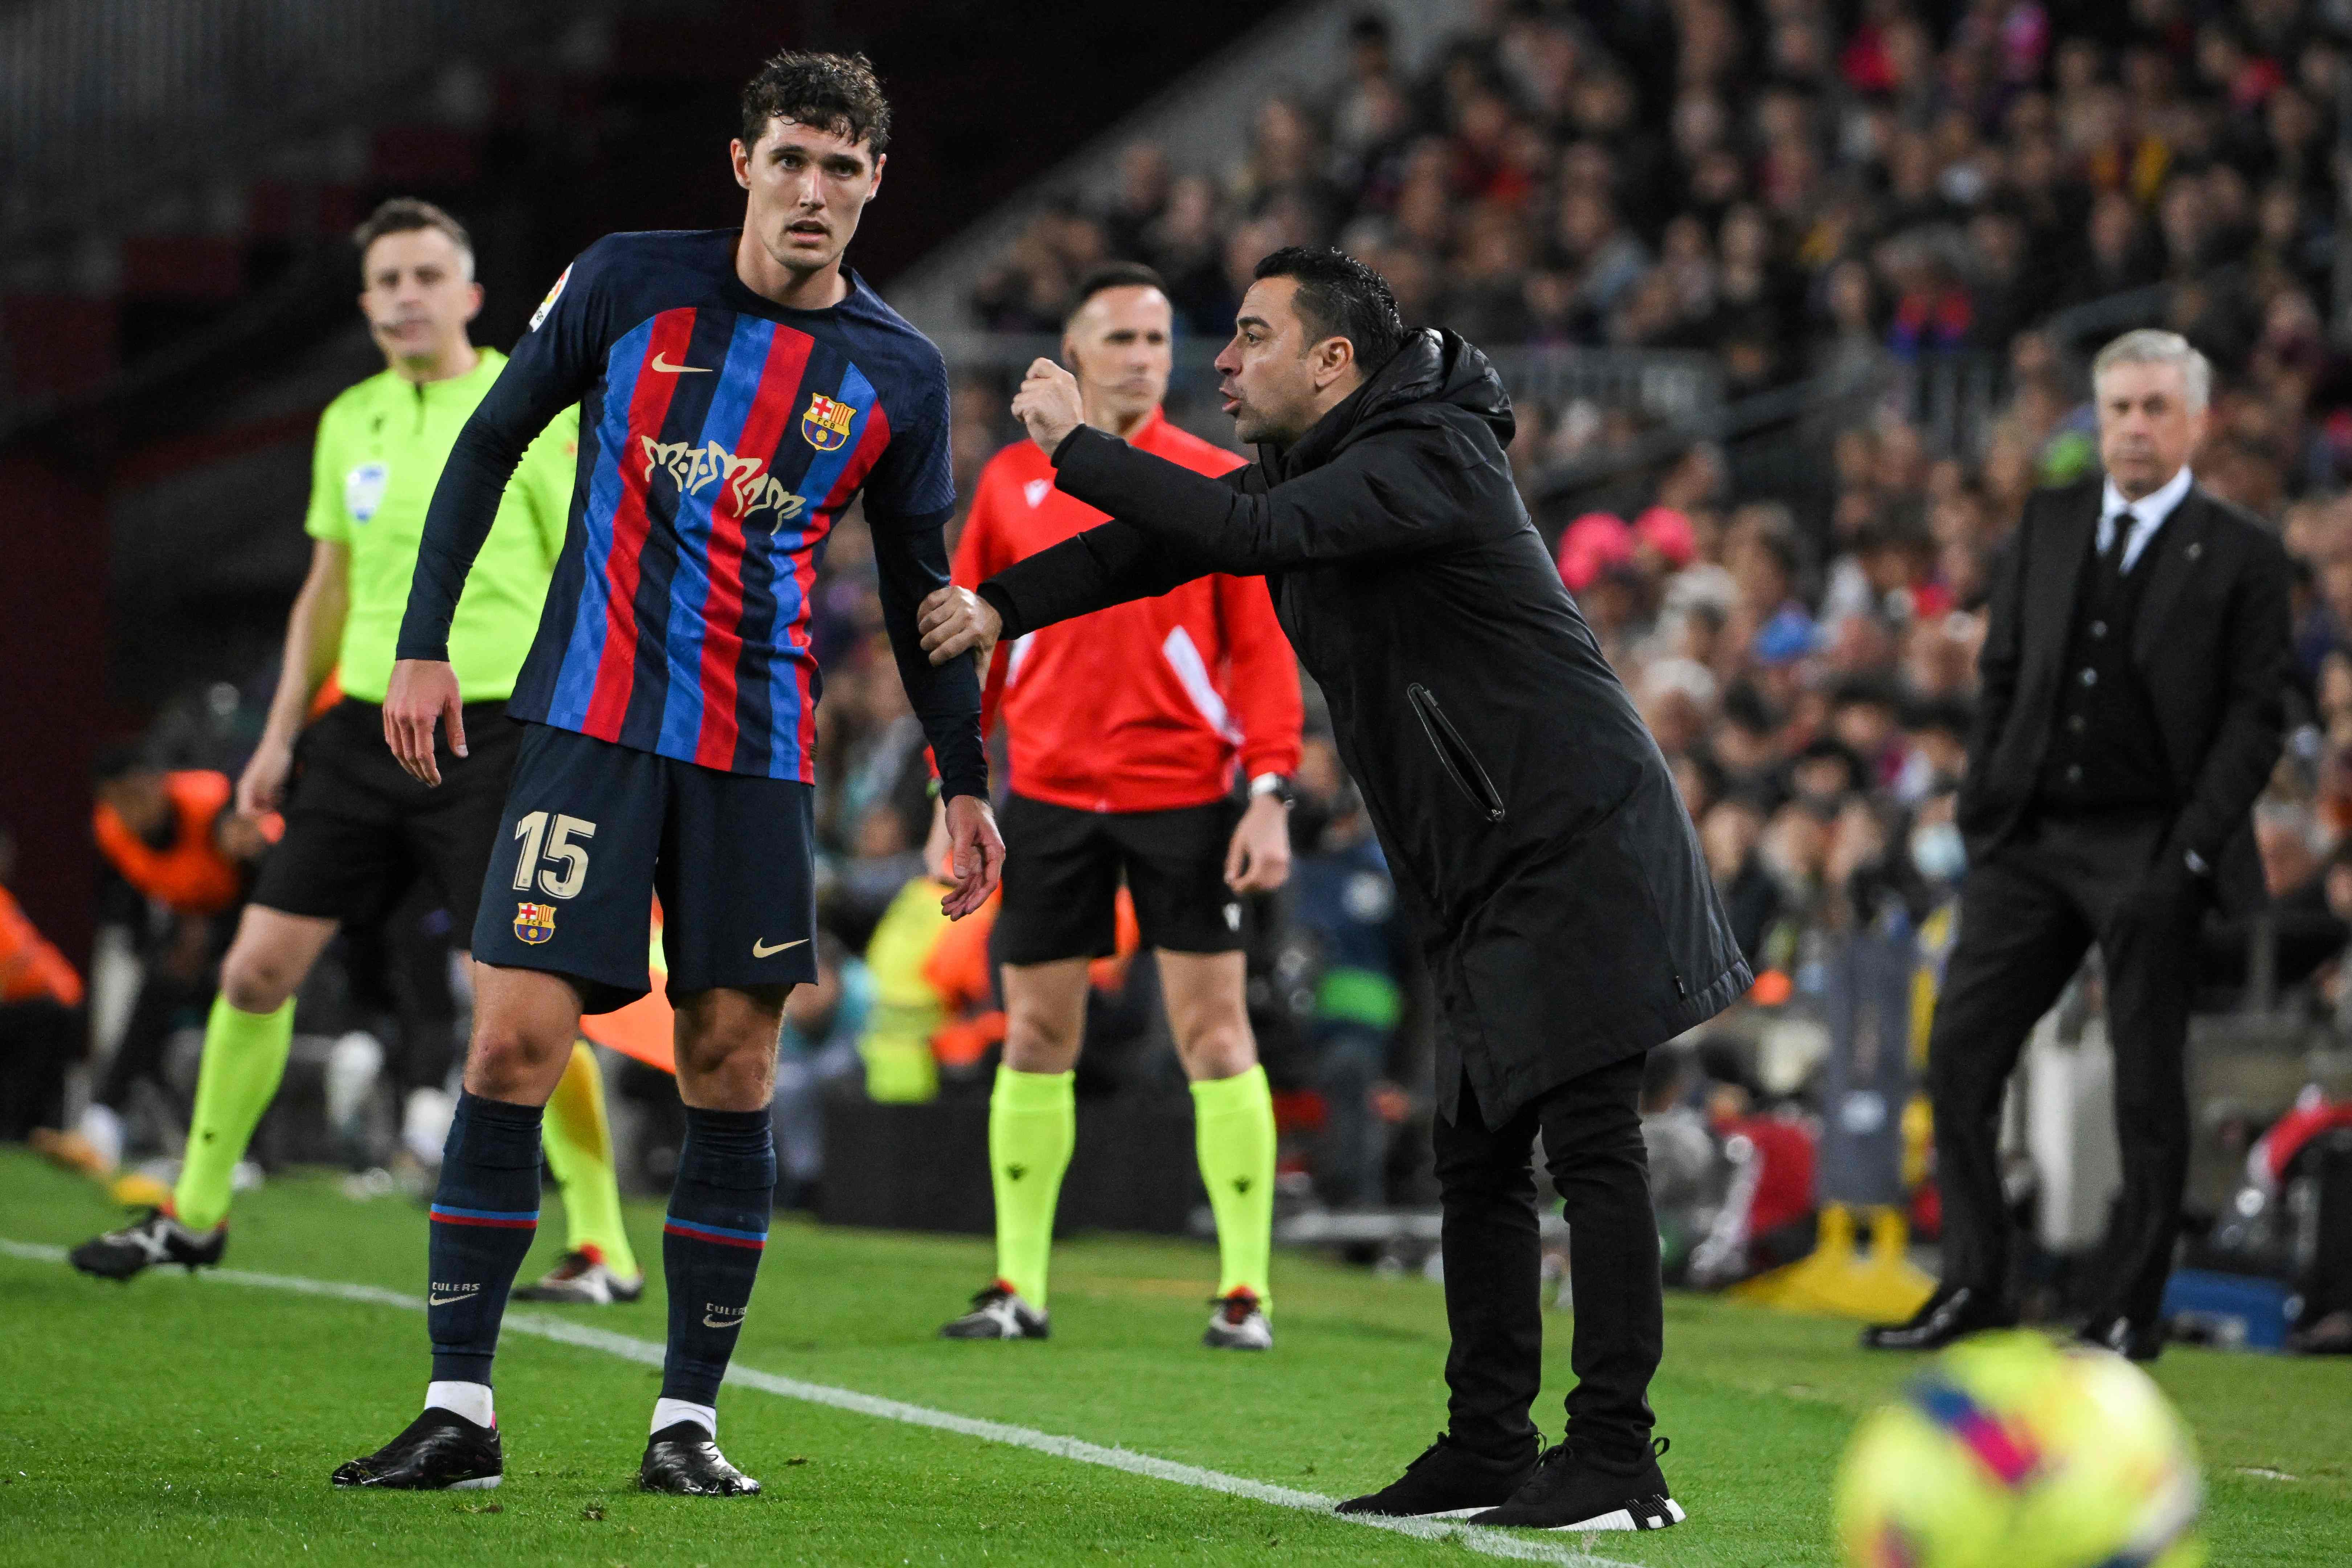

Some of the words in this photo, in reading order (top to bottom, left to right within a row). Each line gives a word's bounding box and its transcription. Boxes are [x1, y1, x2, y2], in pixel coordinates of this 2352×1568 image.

[817, 417, 835, 429] FCB
[513, 811, 596, 899] 15
[432, 1282, 480, 1291] CULERS
[706, 1303, 747, 1315] CULER
